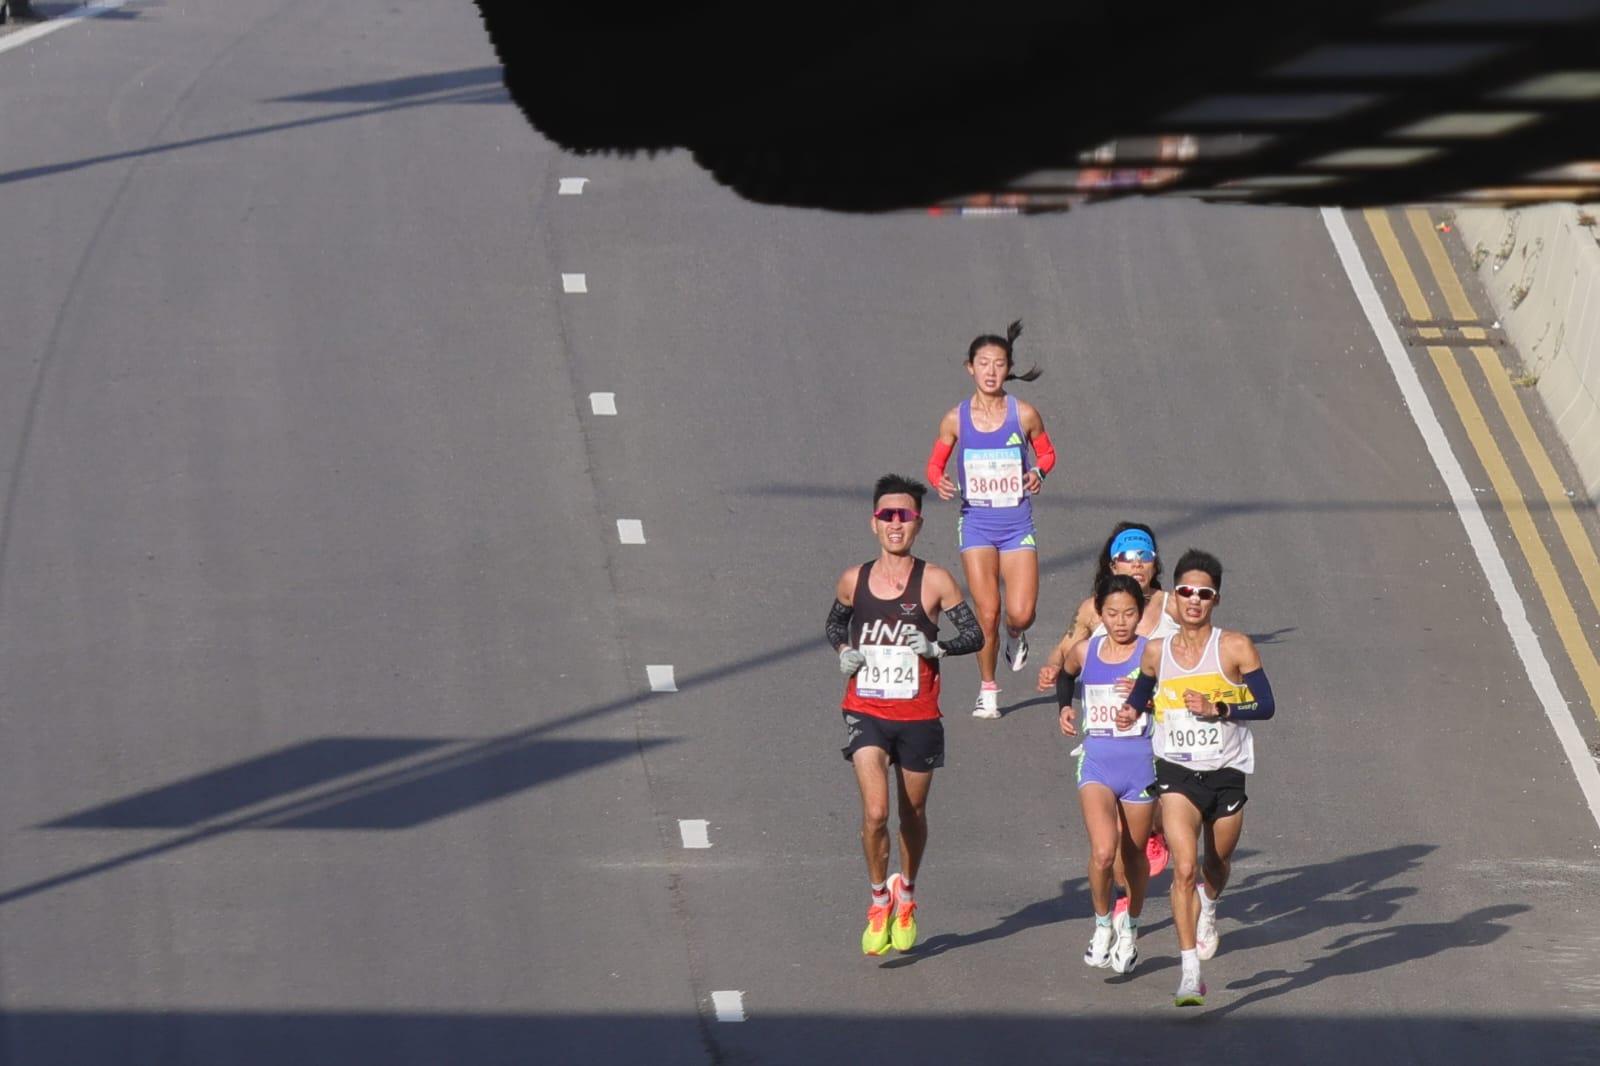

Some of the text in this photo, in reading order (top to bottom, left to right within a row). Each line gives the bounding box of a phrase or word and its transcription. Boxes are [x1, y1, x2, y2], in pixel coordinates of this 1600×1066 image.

[969, 477, 1020, 493] 38006
[863, 667, 915, 684] 19124
[1090, 705, 1117, 723] 380
[1169, 728, 1219, 748] 19032
